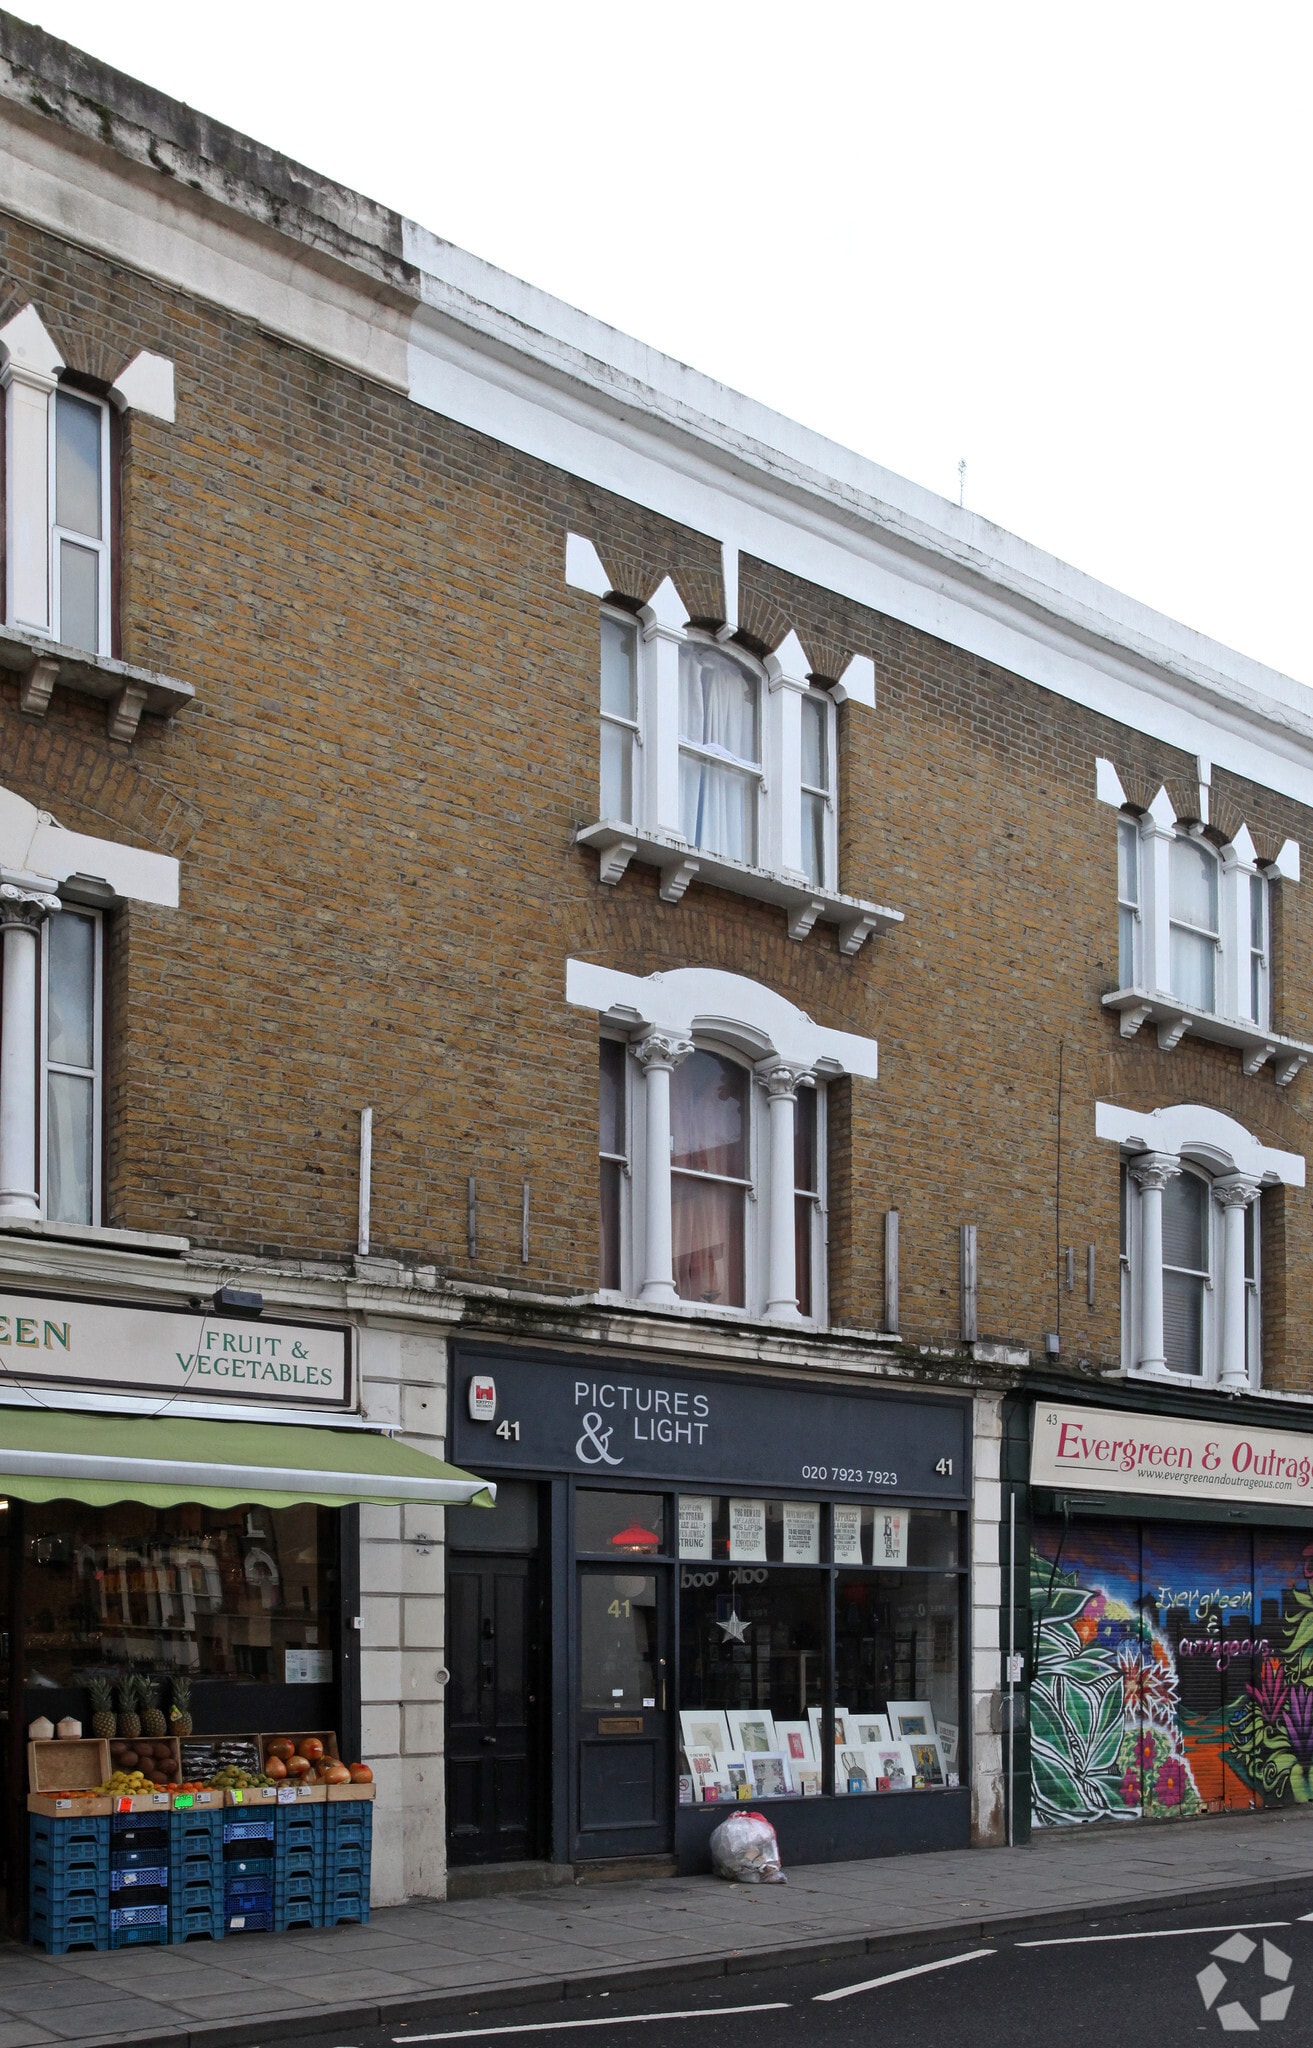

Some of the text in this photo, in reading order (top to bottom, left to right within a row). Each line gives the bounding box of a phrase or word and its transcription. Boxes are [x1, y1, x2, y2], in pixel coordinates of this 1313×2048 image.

[206, 1331, 310, 1360] FRUIT &
[175, 1352, 333, 1386] VEGETABLES
[575, 1381, 710, 1417] PICTURES
[495, 1419, 520, 1441] 41
[1046, 1414, 1058, 1426] 43
[575, 1411, 709, 1466] & LIGHT
[935, 1457, 953, 1476] 41
[1056, 1422, 1313, 1488] Evergreen & Outrag
[801, 1465, 898, 1486] 020 7923 7923
[1137, 1468, 1293, 1490] www.evergreenandoutrageous.com
[607, 1599, 631, 1618] 41
[1155, 1586, 1253, 1619] Evergreen
